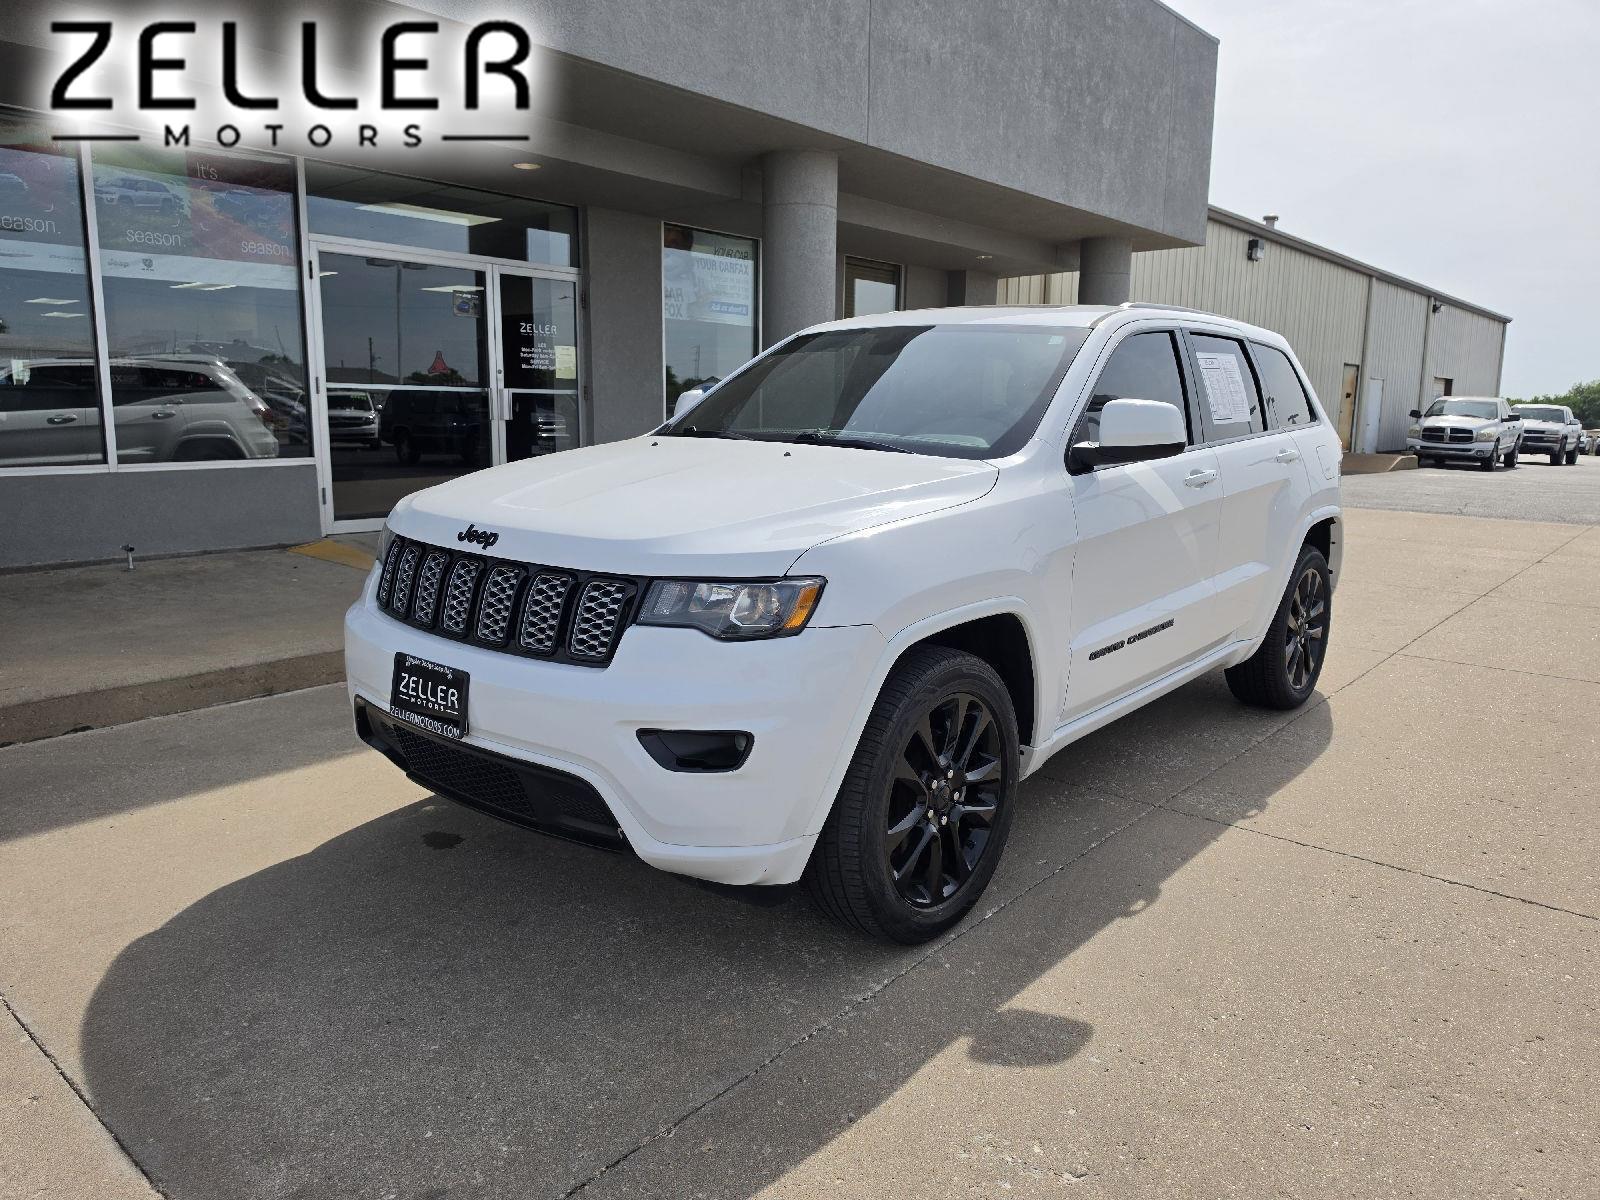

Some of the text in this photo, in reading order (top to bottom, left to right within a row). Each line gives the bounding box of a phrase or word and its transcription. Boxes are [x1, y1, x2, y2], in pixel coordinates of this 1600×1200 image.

[195, 161, 218, 180] It's
[0, 215, 62, 234] eason.
[719, 260, 750, 276] CARFAX
[519, 322, 557, 335] ZELLER
[457, 523, 500, 551] Jeep
[399, 672, 459, 709] ZELLER
[410, 697, 444, 712] MOTORS
[390, 705, 460, 739] ZELLERMOTORS.COM
